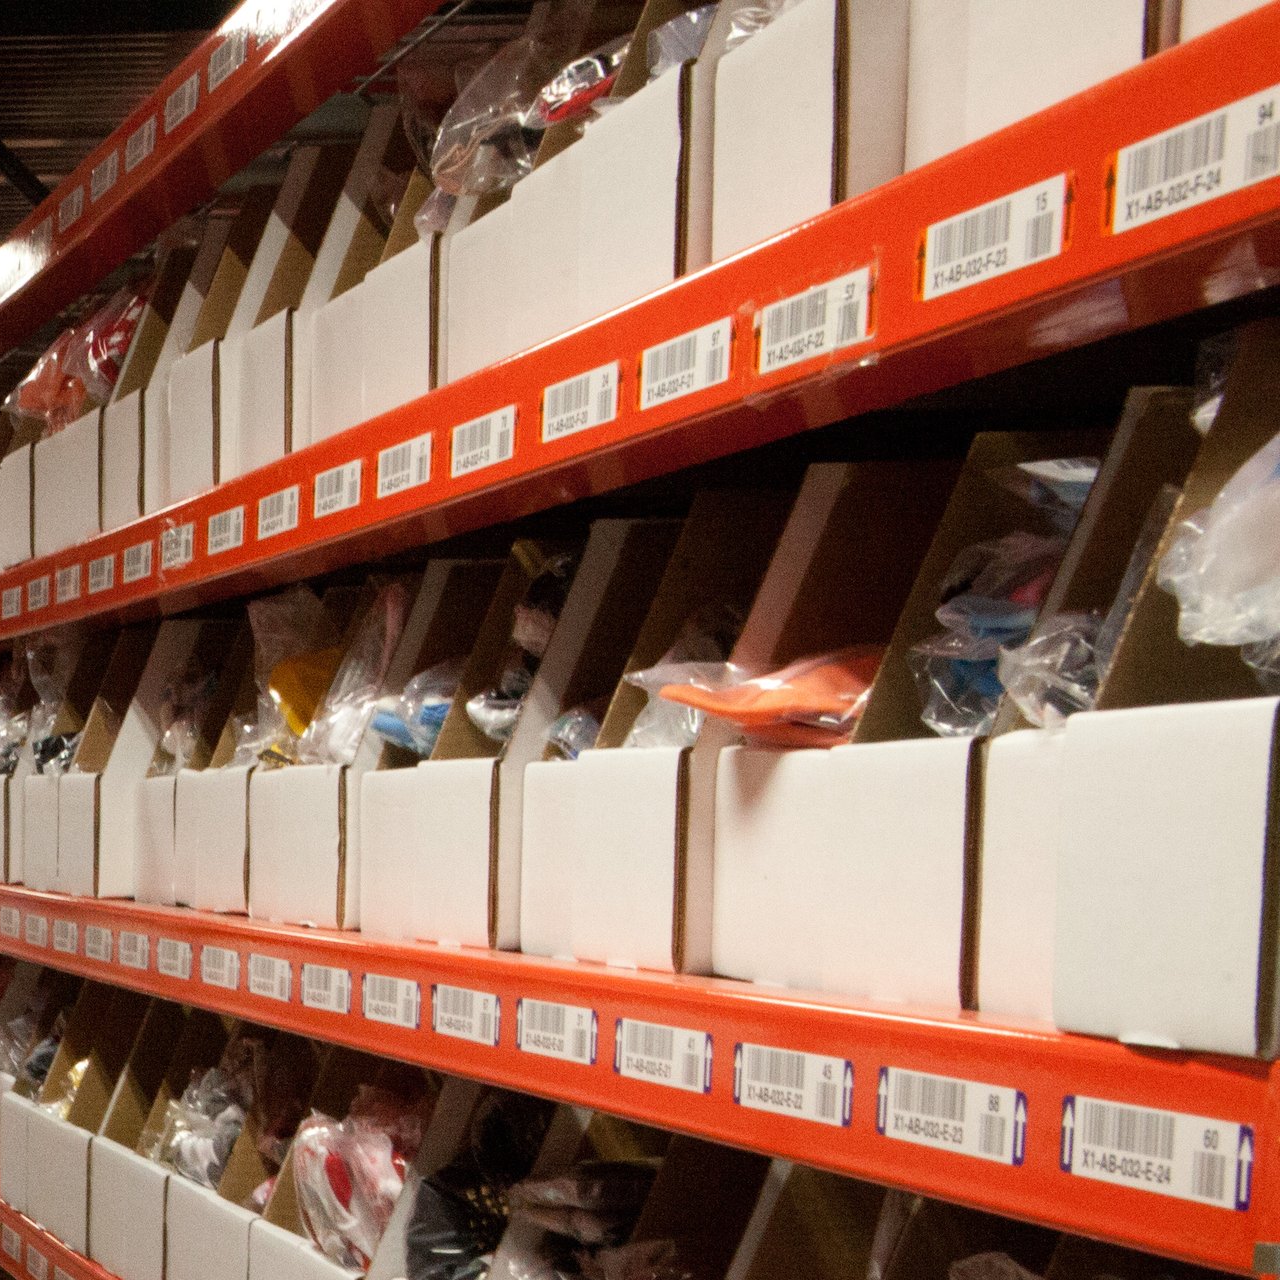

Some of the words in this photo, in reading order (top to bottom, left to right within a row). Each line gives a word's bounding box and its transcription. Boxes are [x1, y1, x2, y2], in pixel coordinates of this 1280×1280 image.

[1256, 101, 1276, 125] 94
[1034, 189, 1048, 214] 15
[1125, 163, 1222, 222] X1-AB-032-F-24
[933, 245, 1008, 291] X1-AB-032-F-23
[646, 371, 694, 403] X1-AB-032-F-21
[747, 1083, 803, 1111] X1-AB-032-E-22
[893, 1112, 963, 1146] X1-AB-032-E-23
[1202, 1127, 1219, 1151] 60
[1081, 1147, 1172, 1187] X1-AB-032-E-24
